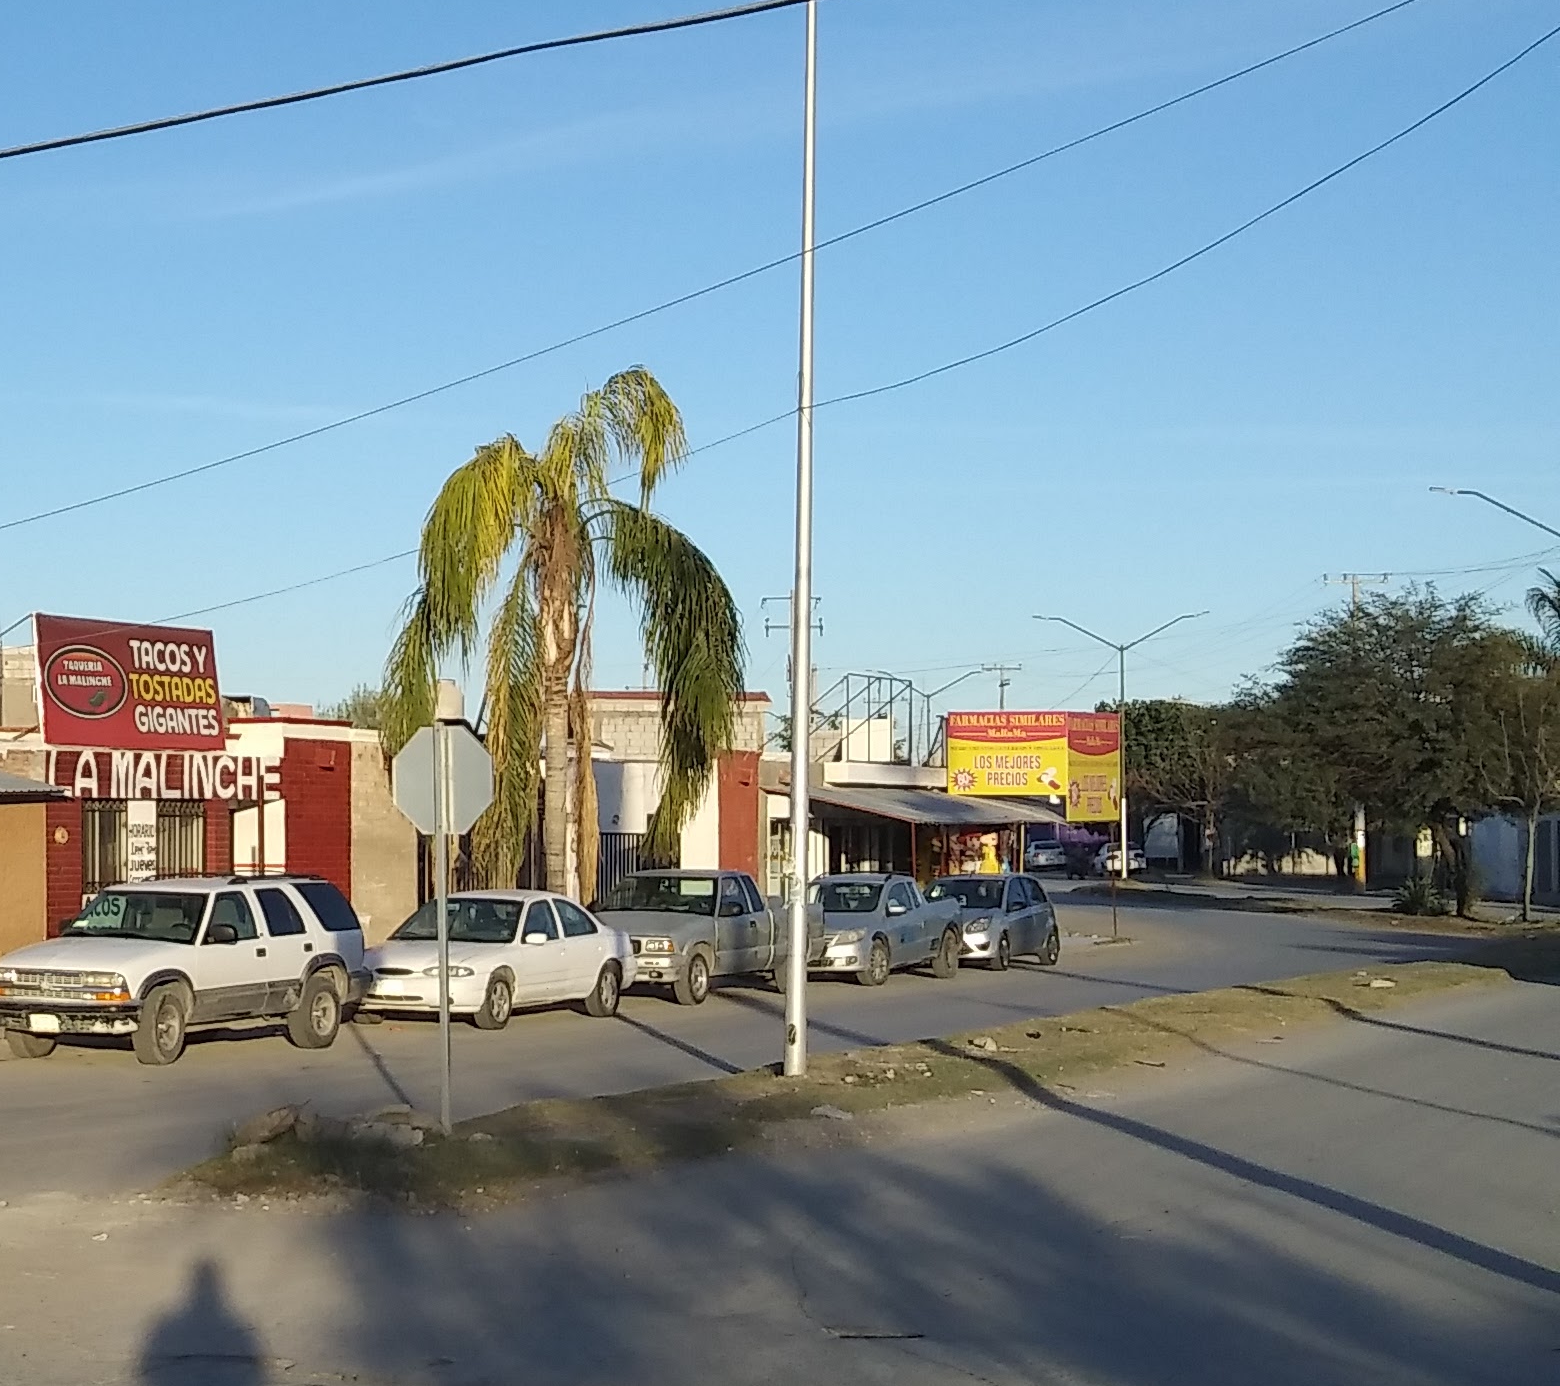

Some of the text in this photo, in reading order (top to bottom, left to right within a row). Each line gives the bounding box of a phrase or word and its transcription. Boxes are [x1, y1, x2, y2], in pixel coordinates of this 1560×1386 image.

[129, 639, 207, 674] TACOS Y
[63, 660, 103, 672] TAQUERIA
[57, 674, 112, 687] LA MALINCHE
[129, 673, 216, 704] TOSTADAS
[135, 705, 219, 736] GIGANTES
[949, 714, 1007, 727] FARMACIAS
[1009, 714, 1065, 727] SIMILARES
[973, 755, 1041, 770] LOS MEJORES
[49, 750, 281, 800] LA MALINCHE
[987, 771, 1028, 786] PRECIOS
